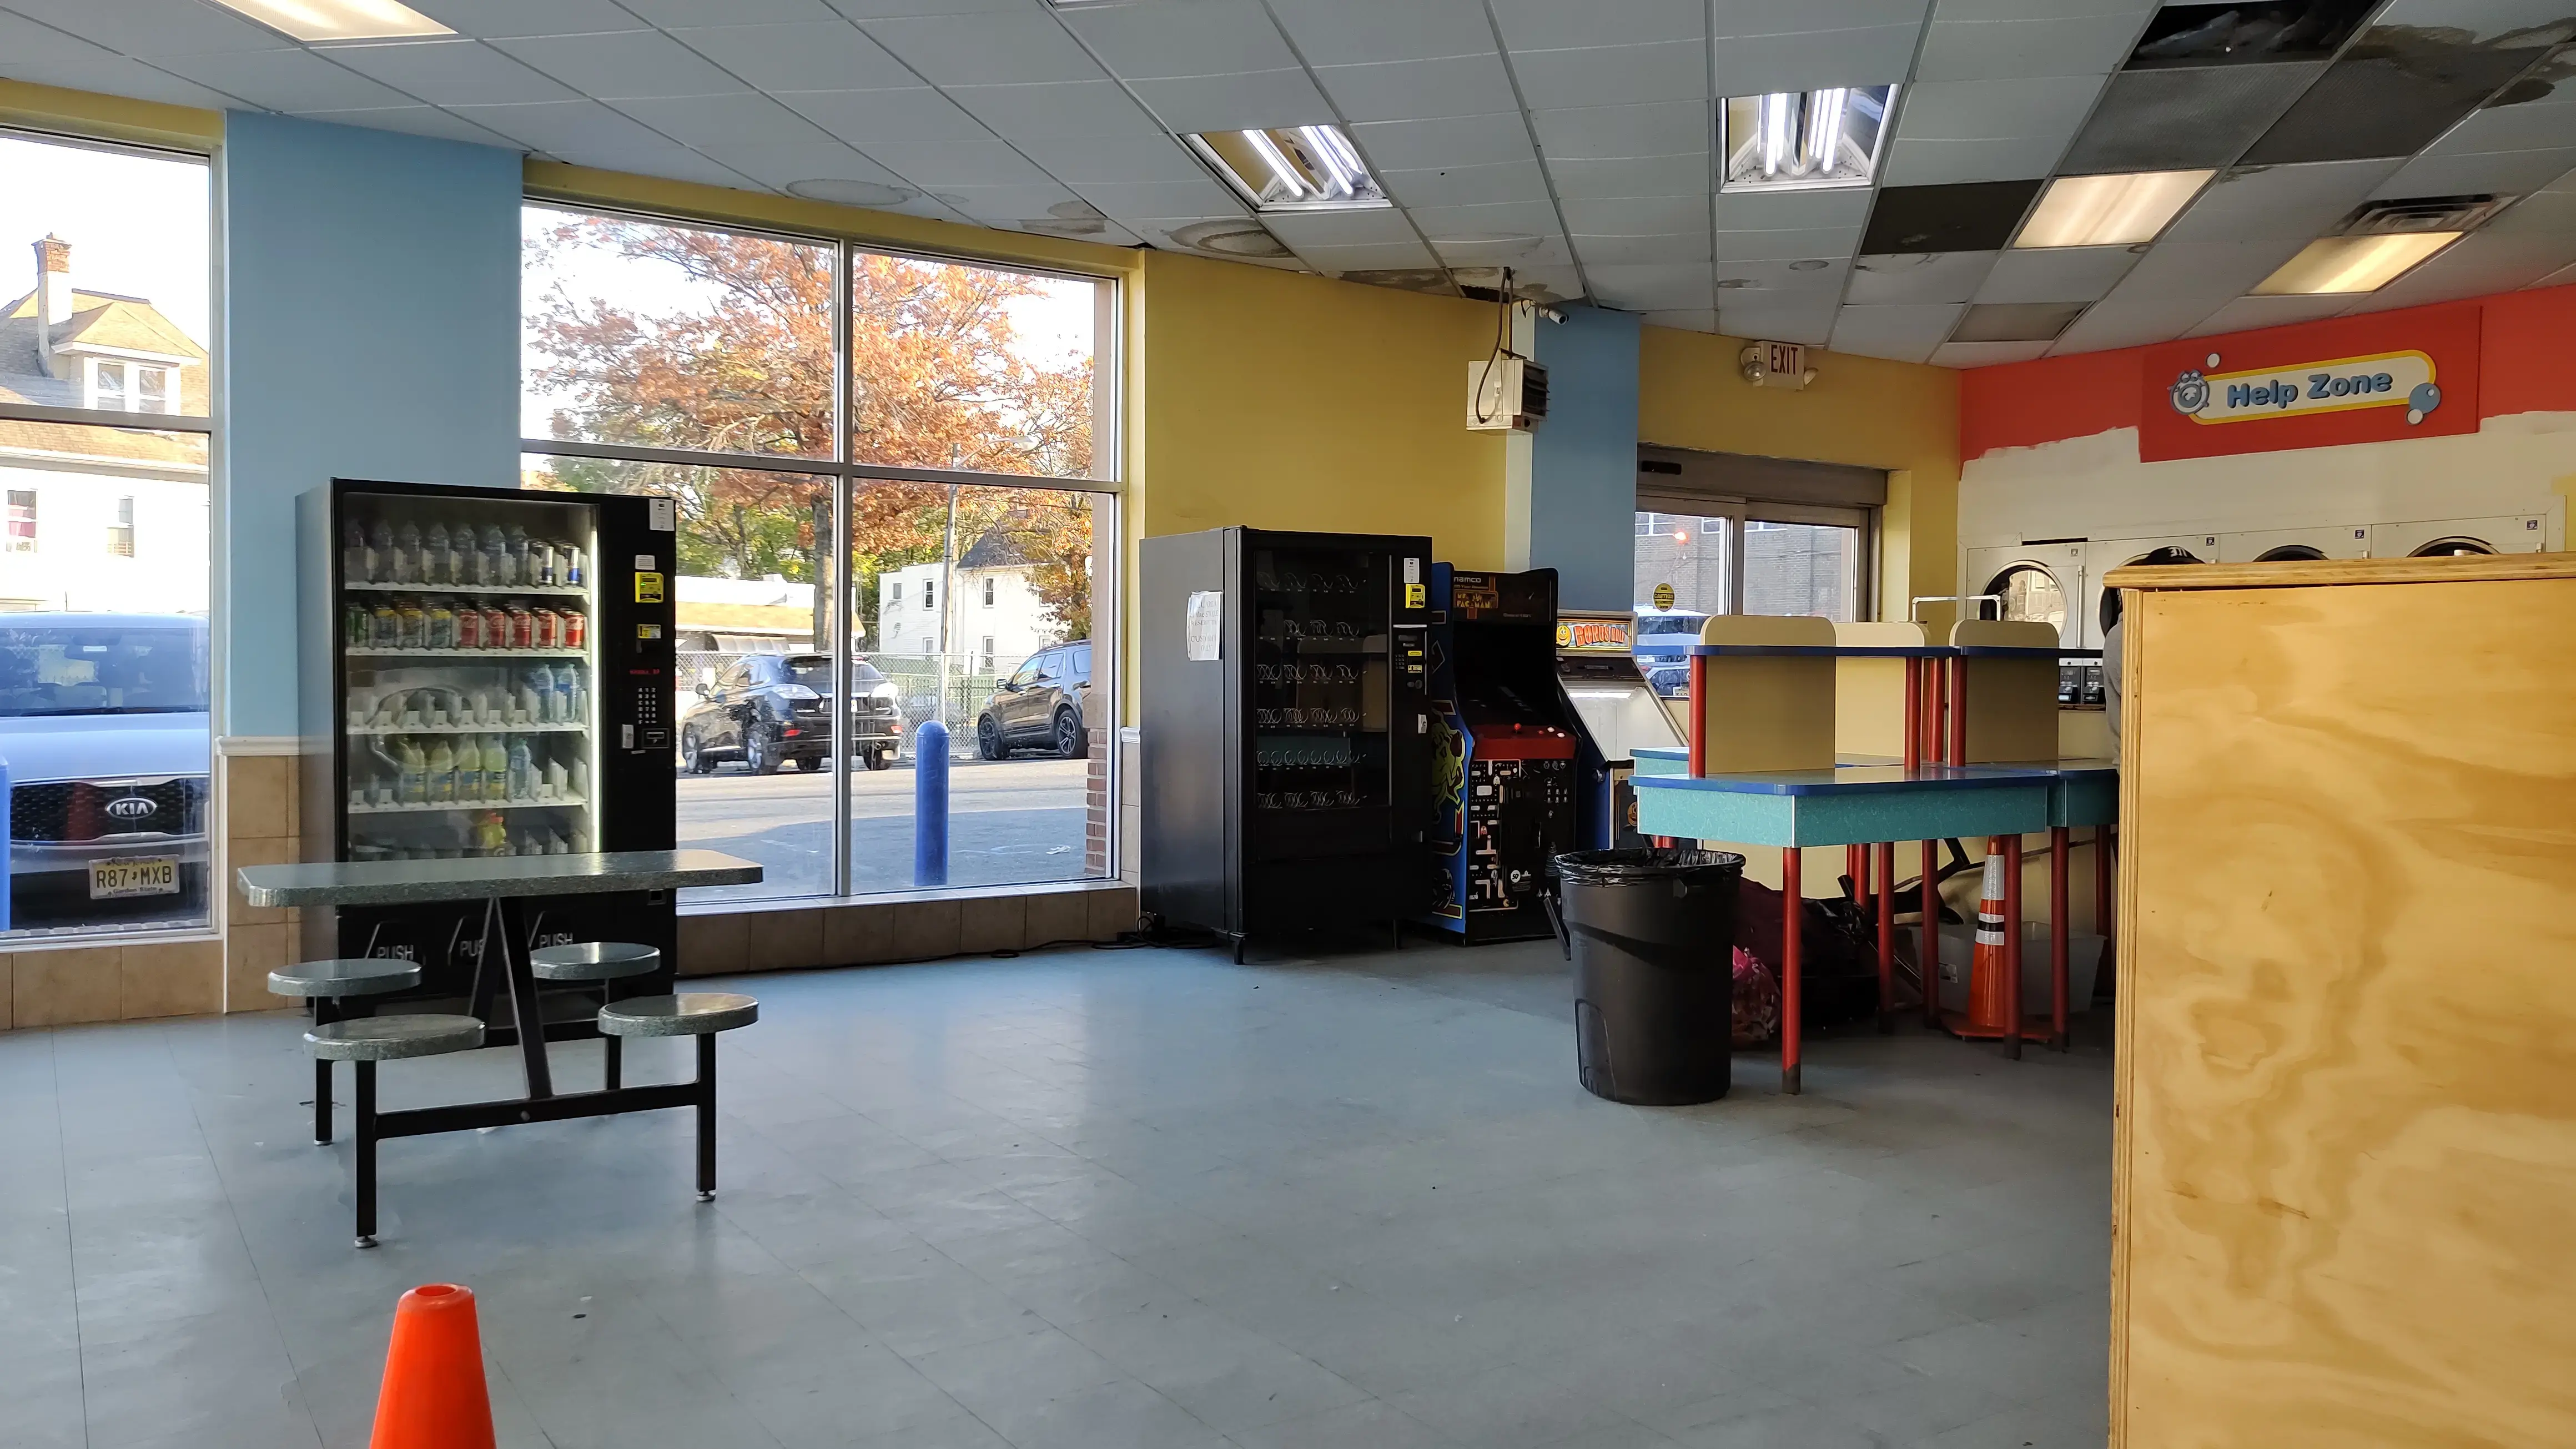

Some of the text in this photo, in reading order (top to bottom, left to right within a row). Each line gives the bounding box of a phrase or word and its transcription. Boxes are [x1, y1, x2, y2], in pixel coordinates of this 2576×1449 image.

[1771, 344, 1798, 375] EXIT
[2227, 373, 2393, 409] Help Zone
[1573, 625, 1610, 647] BONUS
[115, 802, 149, 816] KIA
[96, 866, 172, 889] R87 MXB
[539, 933, 573, 948] PUSH
[377, 945, 414, 961] PUSH
